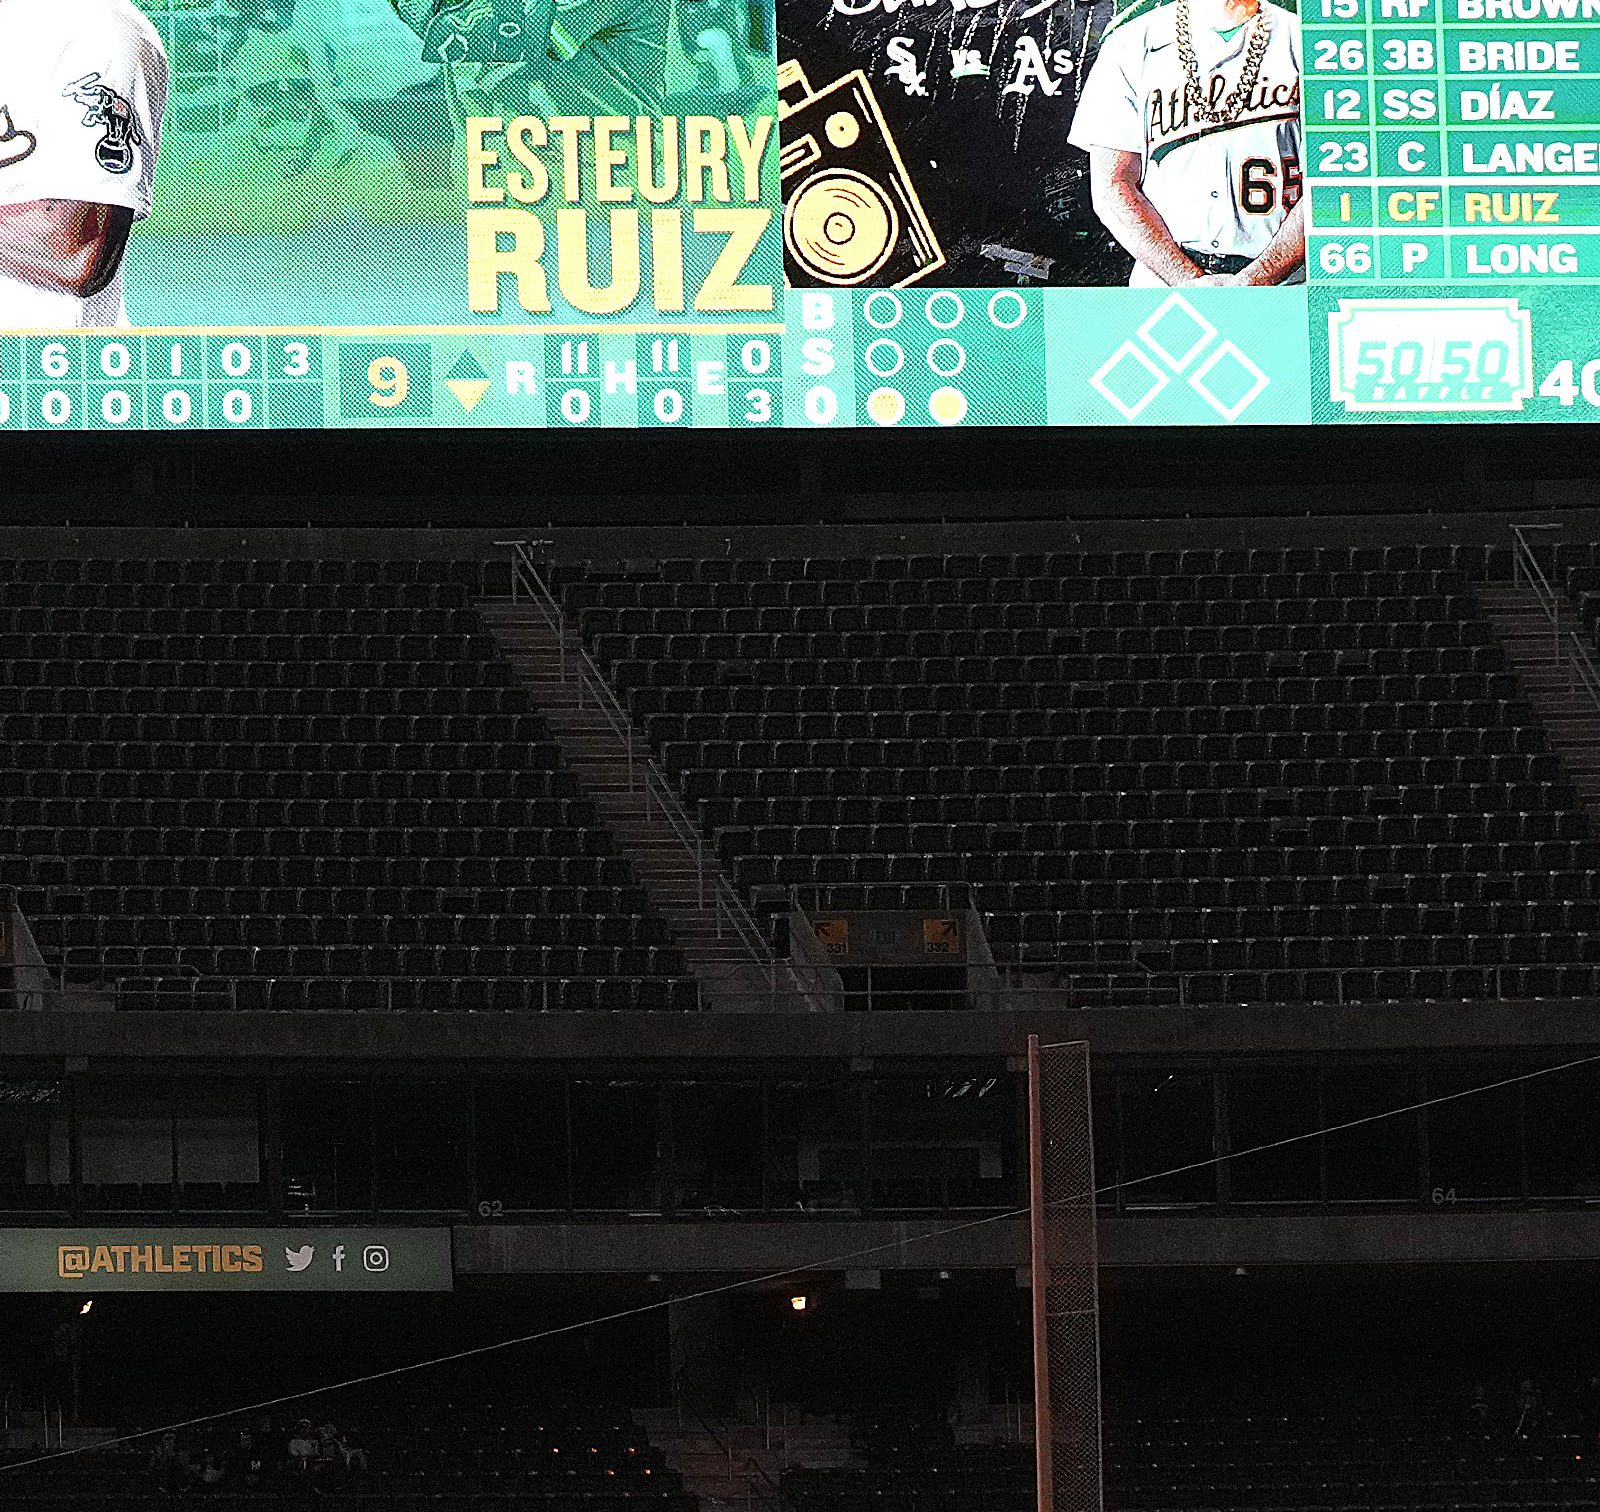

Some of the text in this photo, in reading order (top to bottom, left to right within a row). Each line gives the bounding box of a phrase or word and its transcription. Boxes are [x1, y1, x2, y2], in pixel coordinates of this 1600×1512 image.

[1314, 40, 1580, 71] 26 3B BRIDE
[1325, 83, 1555, 120] 12 SS DÍAZ
[466, 116, 773, 203] ESTEURY
[1319, 141, 1425, 172] 23 C
[1388, 192, 1440, 221] CF
[1465, 192, 1560, 222] RUIZ
[468, 209, 774, 313] RUIZ
[1319, 244, 1578, 274] 66 P LONG
[802, 293, 834, 330] B
[742, 341, 770, 374] 0
[802, 338, 835, 376] S
[367, 357, 408, 407] 9
[506, 361, 536, 394] R
[605, 360, 636, 394] H
[697, 361, 725, 394] E
[561, 391, 590, 424] 0
[654, 390, 682, 423] 0
[745, 389, 773, 422] 3
[478, 1200, 504, 1218] 62
[1432, 1188, 1458, 1205] 64
[57, 1244, 265, 1279] @ATHLETICS
